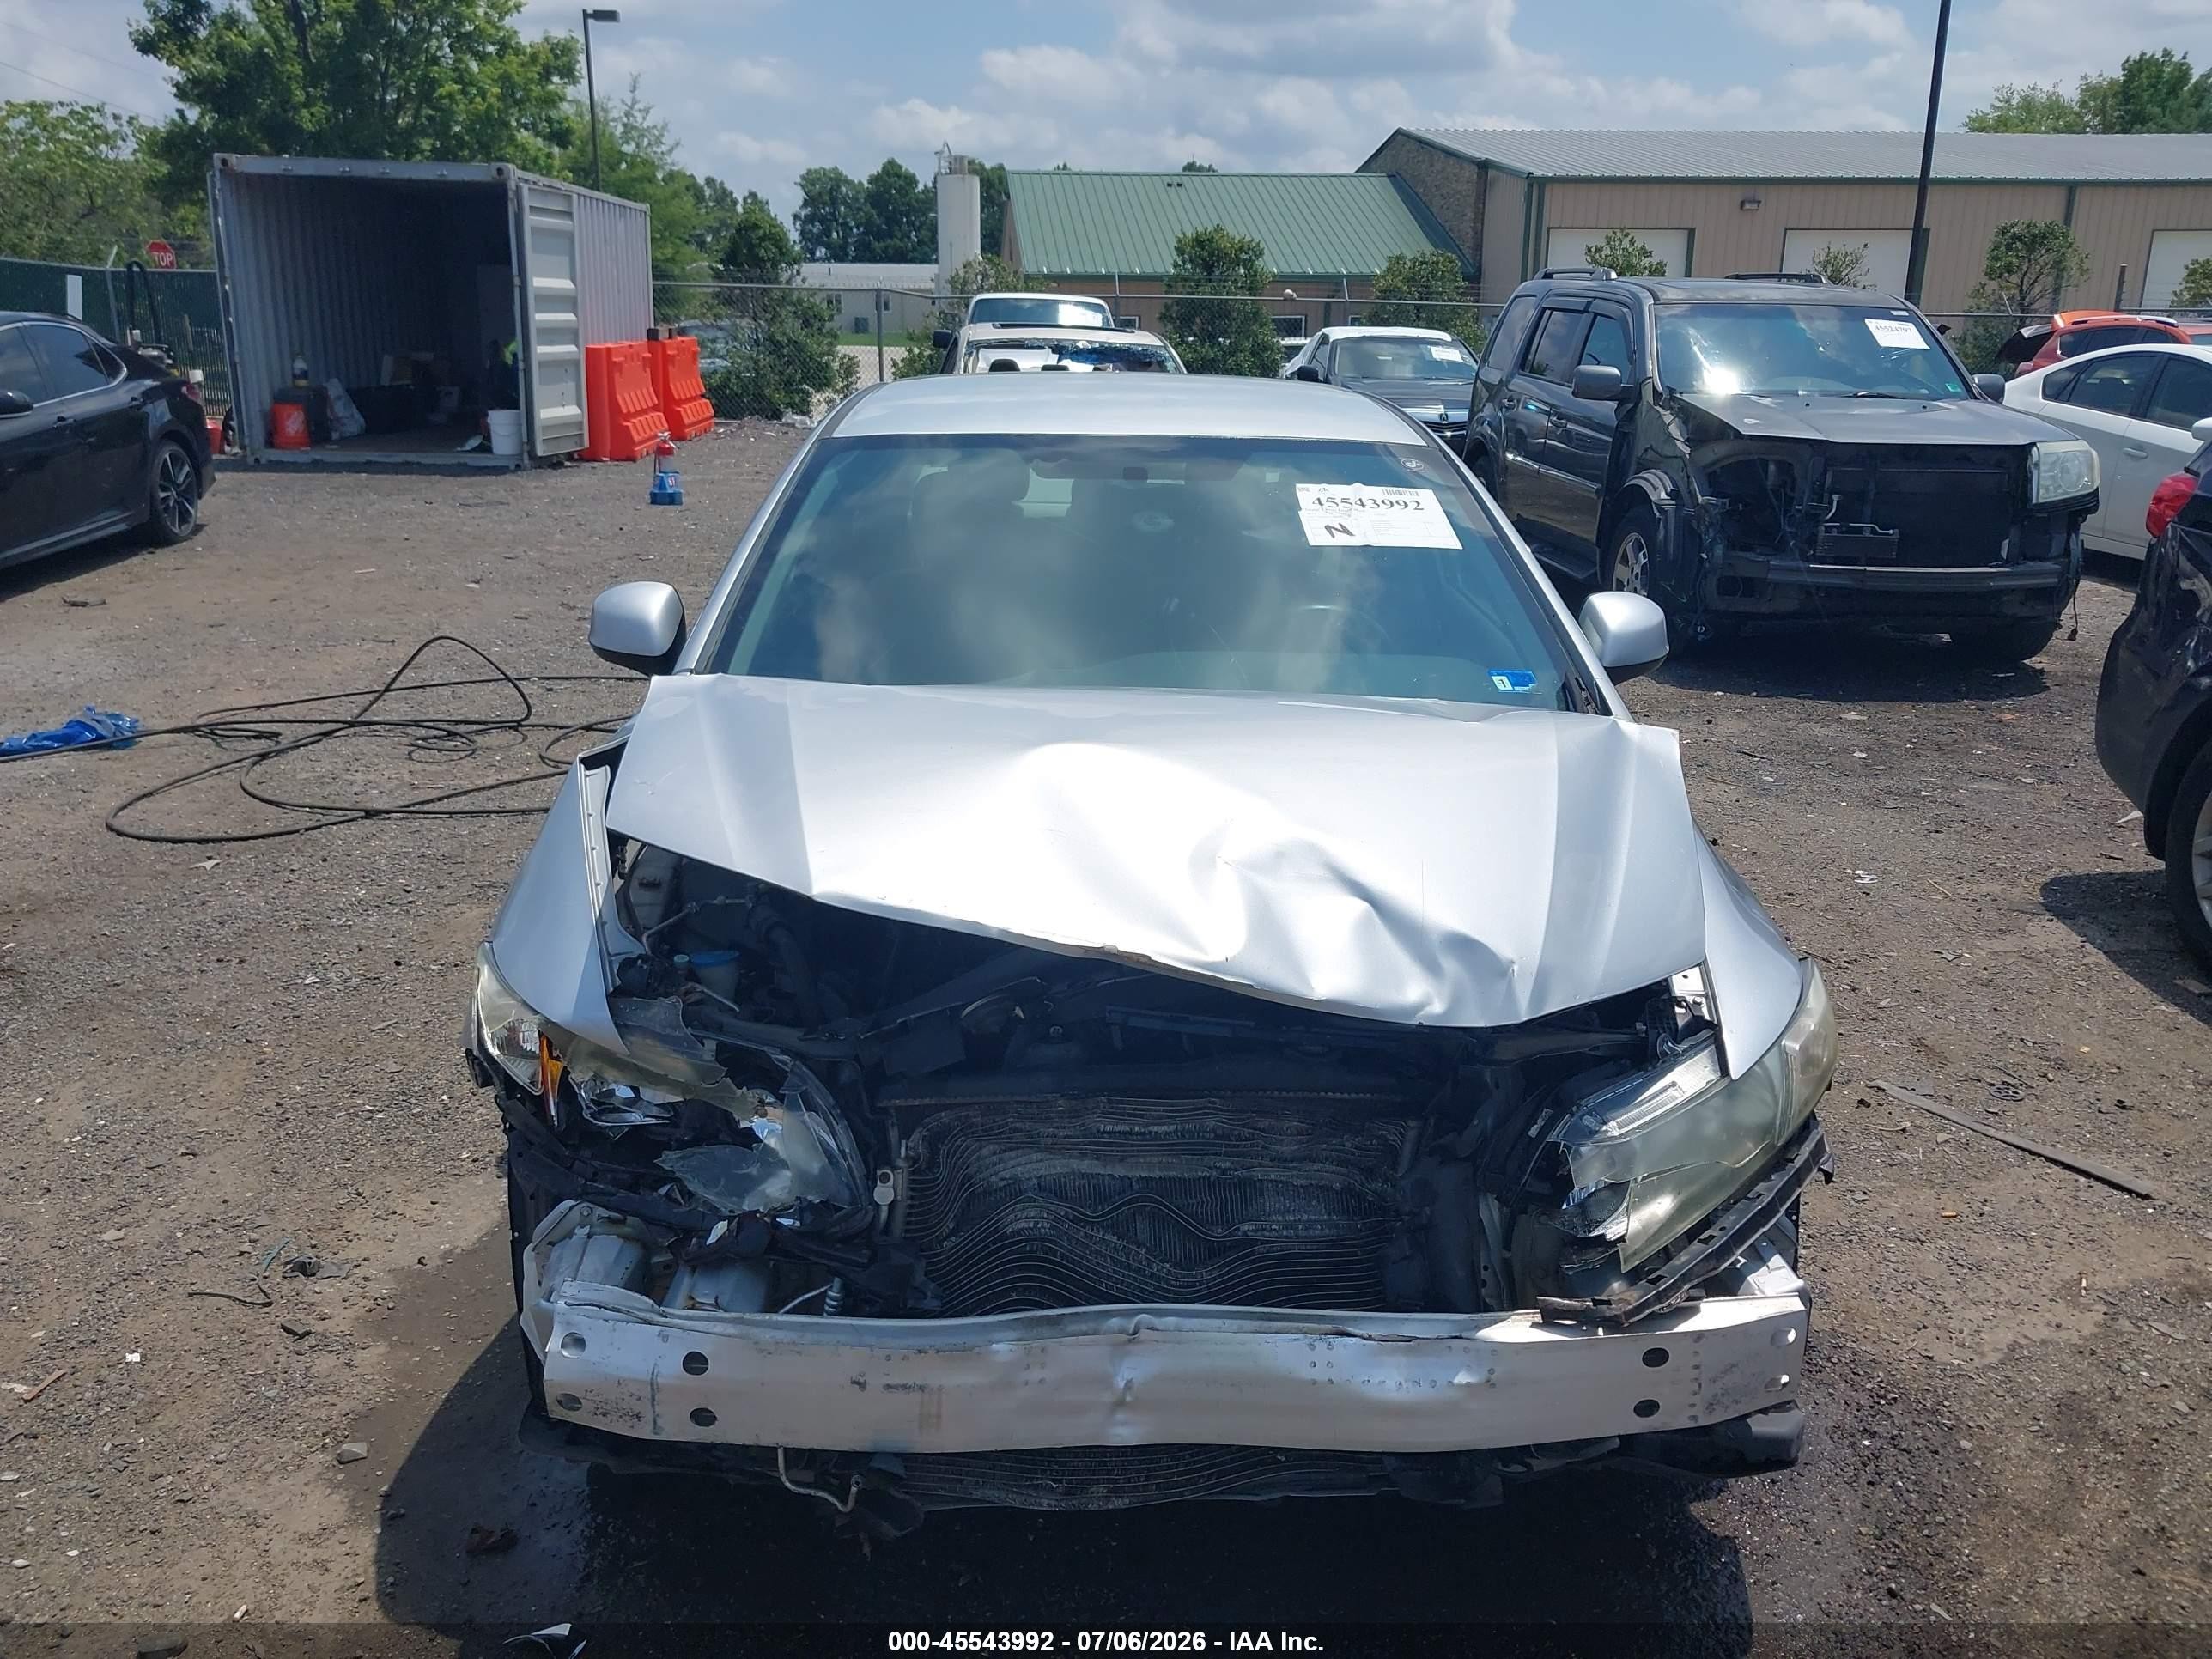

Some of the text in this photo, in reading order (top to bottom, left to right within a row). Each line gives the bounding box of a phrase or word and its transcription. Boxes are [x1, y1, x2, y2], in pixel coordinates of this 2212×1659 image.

[150, 252, 173, 267] TOP
[1311, 496, 1425, 512] 45543992
[1324, 522, 1356, 539] N
